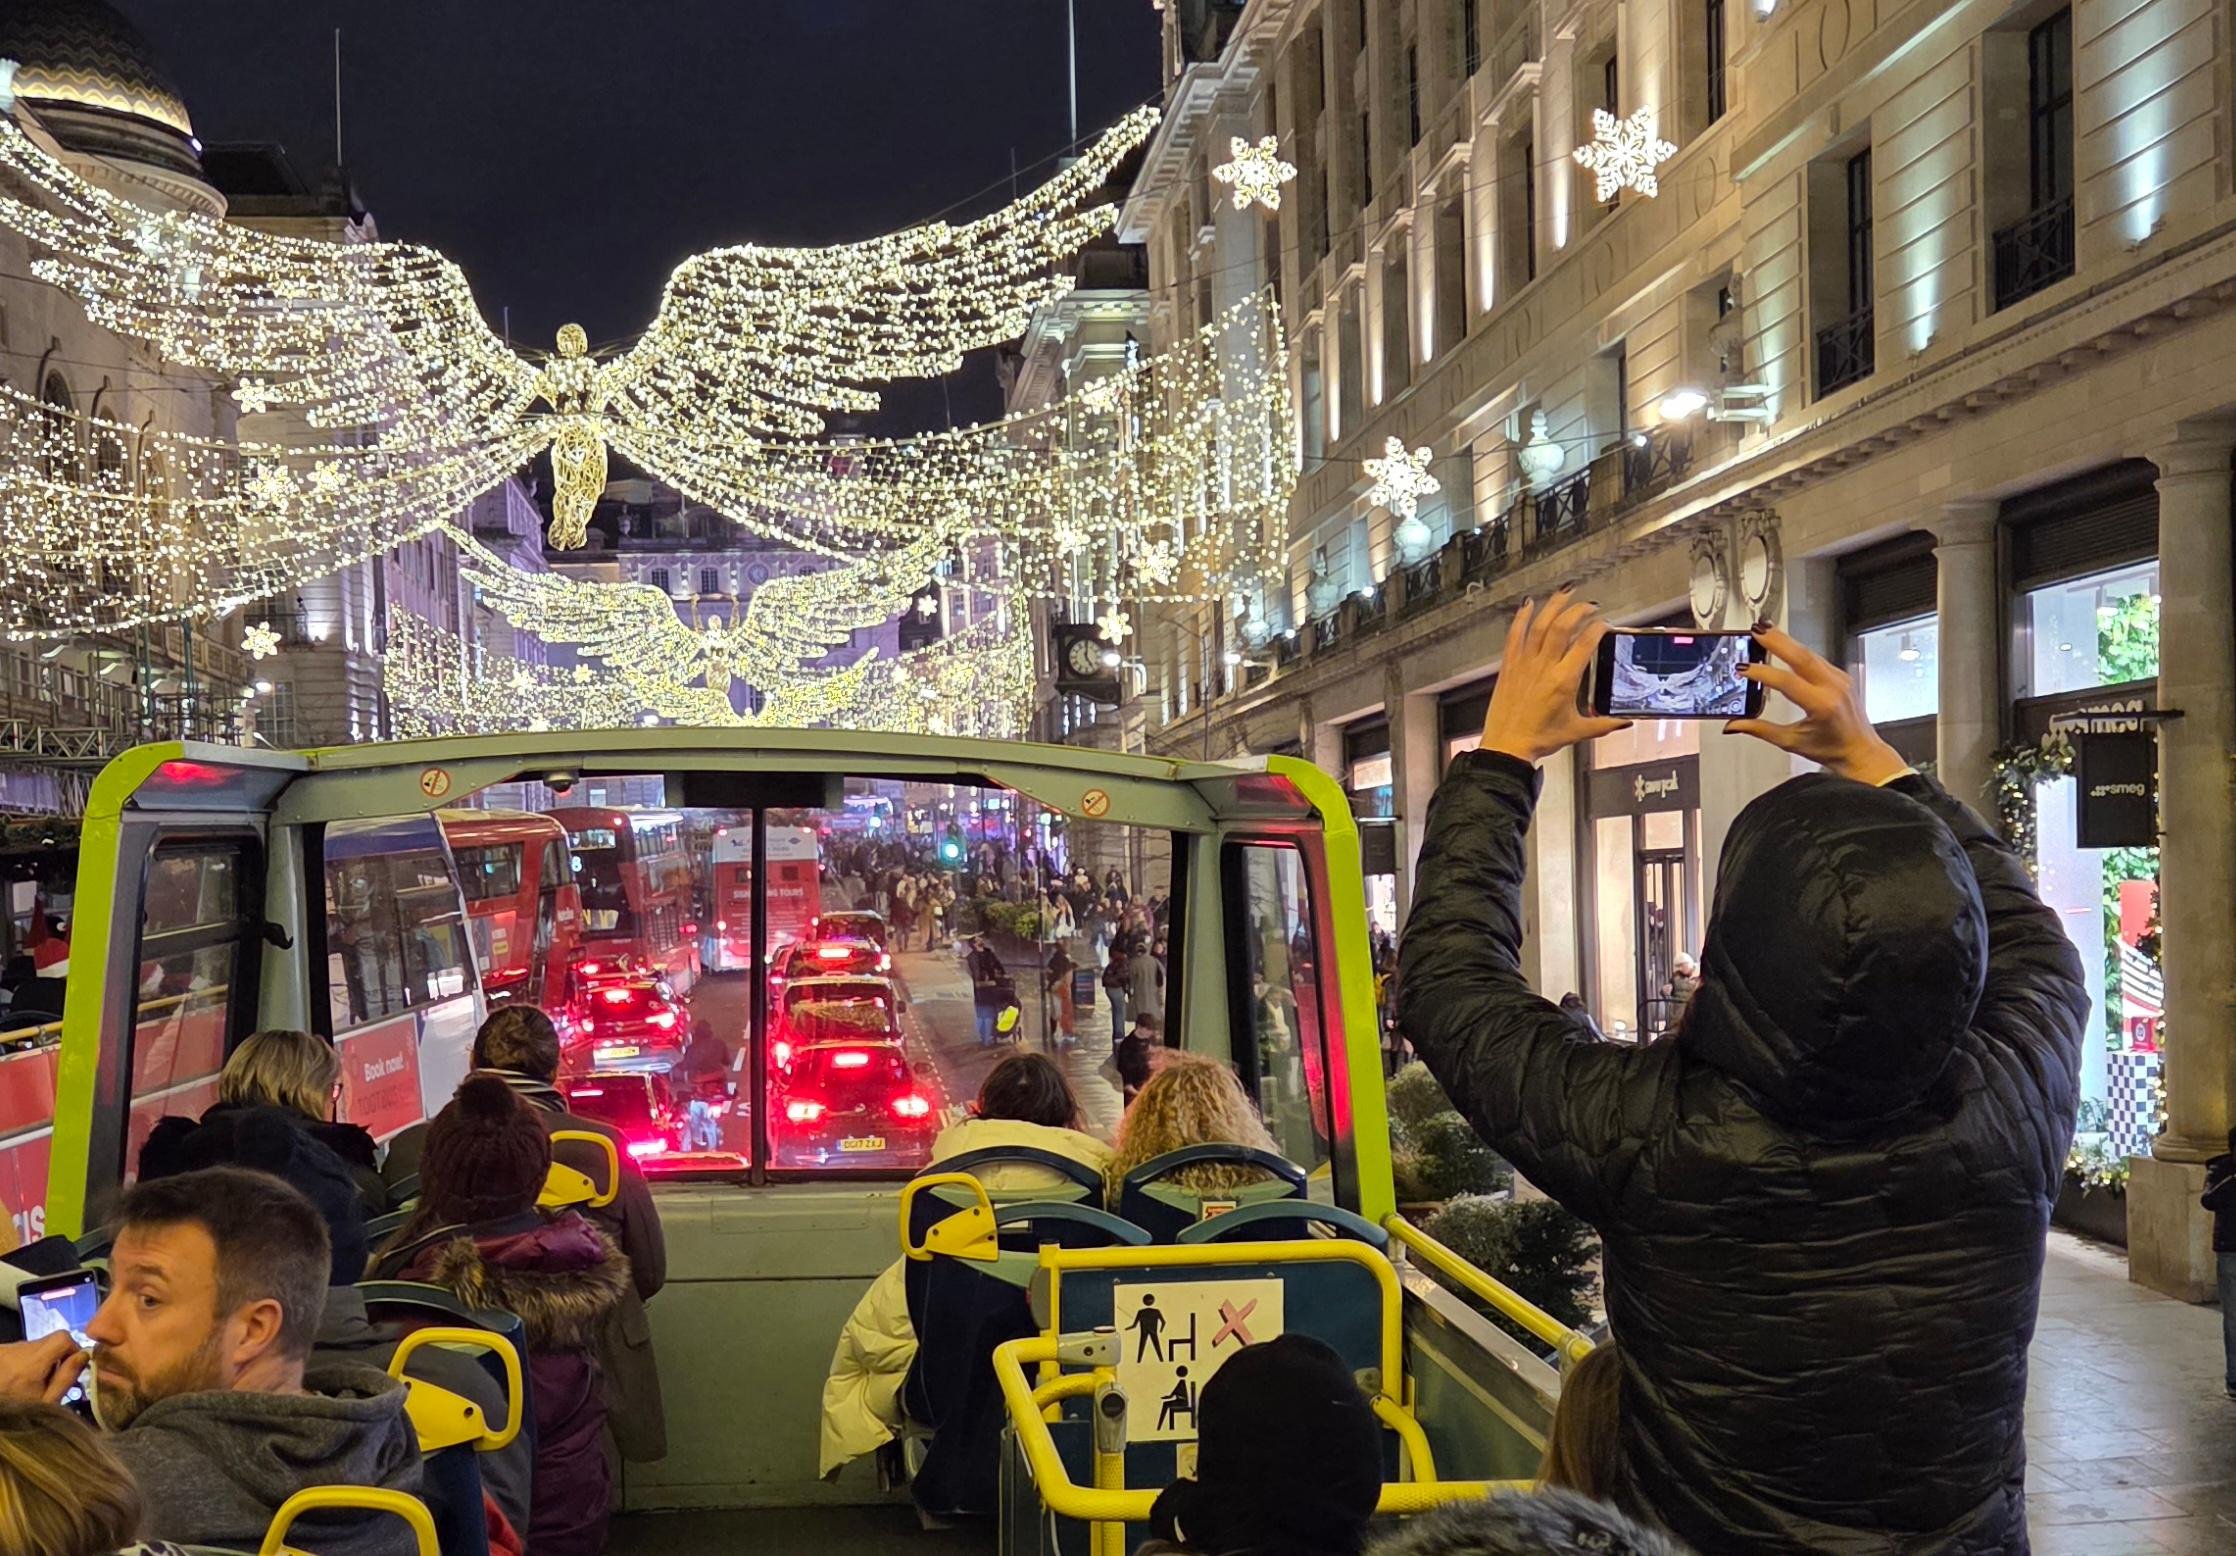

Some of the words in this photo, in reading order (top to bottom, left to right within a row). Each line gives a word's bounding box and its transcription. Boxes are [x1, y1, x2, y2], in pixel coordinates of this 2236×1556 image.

[2110, 784, 2144, 796] smeg
[780, 888, 803, 896] TOURS
[364, 1058, 385, 1082] Book
[386, 1051, 404, 1074] now!
